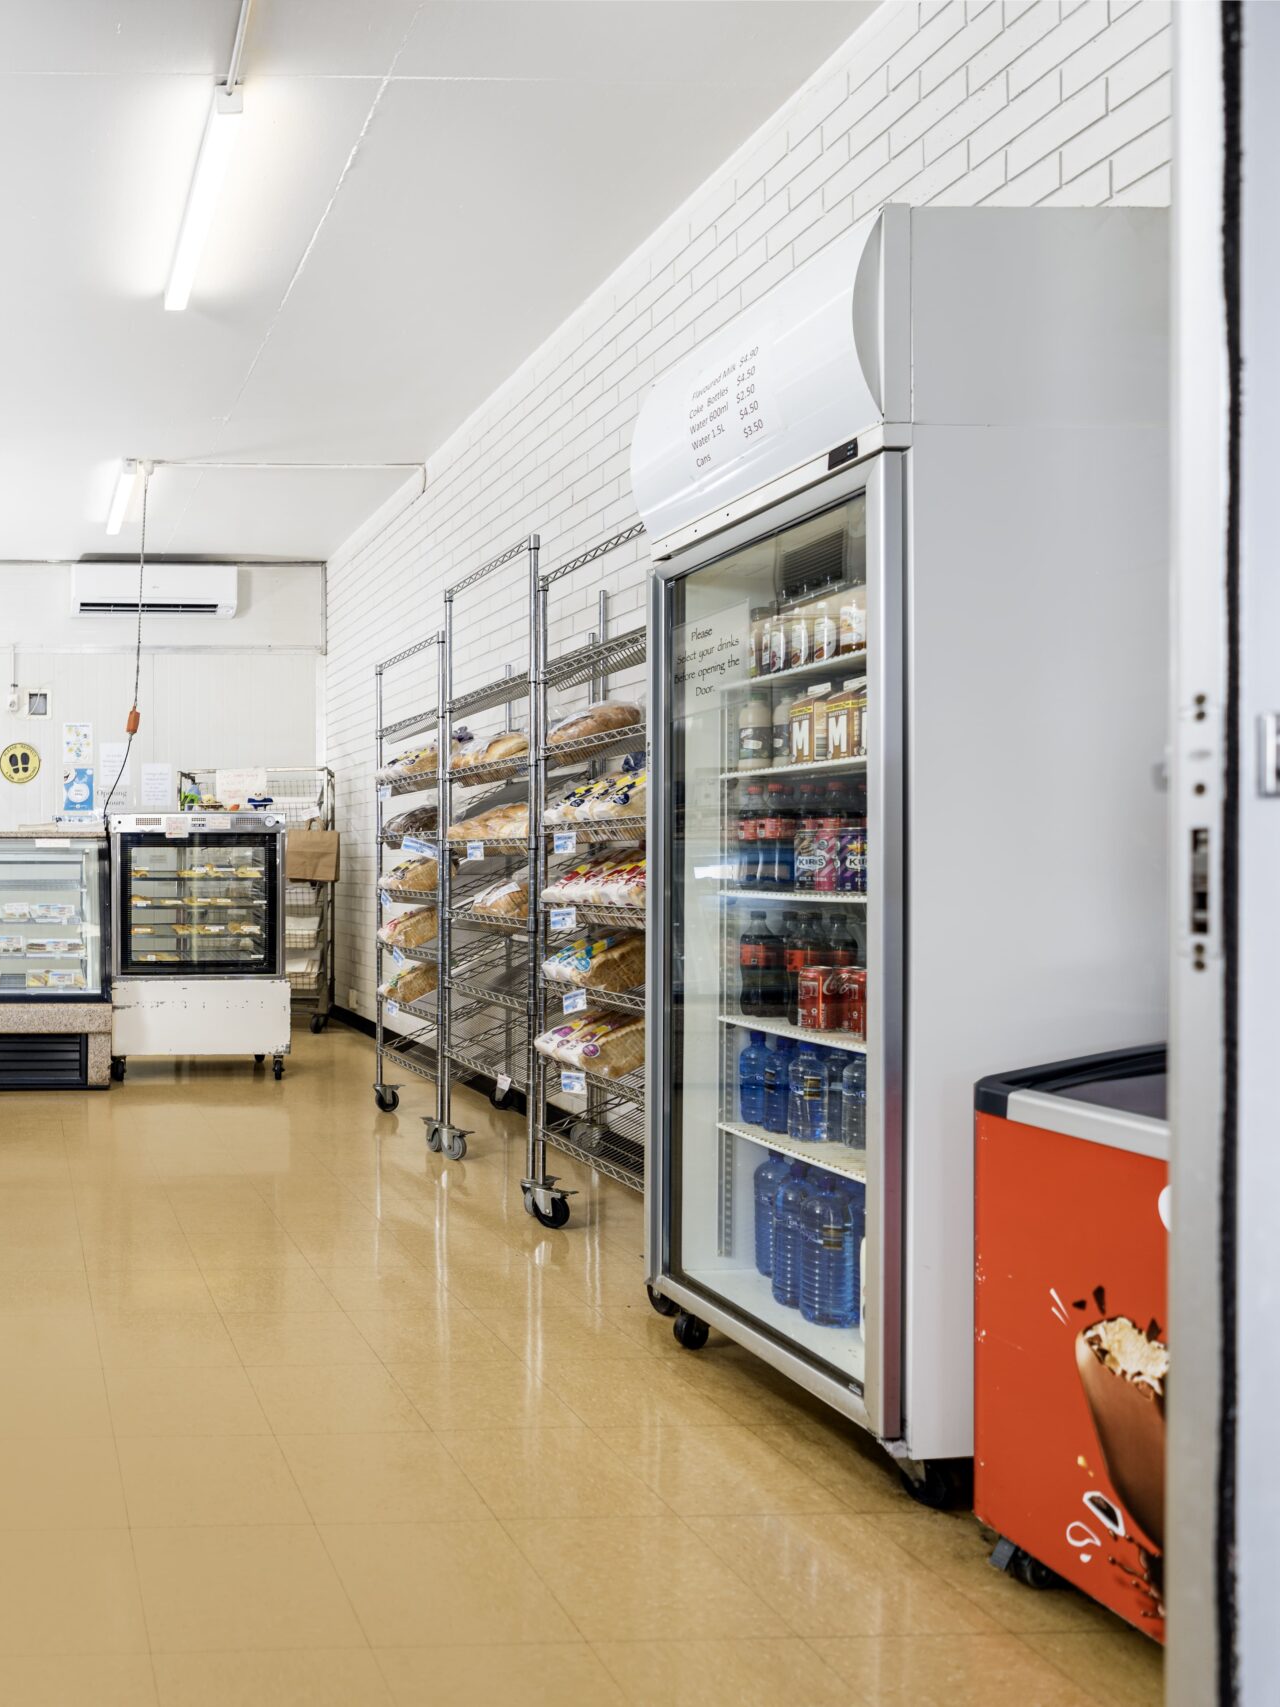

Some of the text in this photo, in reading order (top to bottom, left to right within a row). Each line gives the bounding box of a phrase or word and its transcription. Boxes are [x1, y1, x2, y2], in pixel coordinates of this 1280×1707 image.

[689, 365, 756, 419] Coke Bottles $4.50
[689, 383, 755, 435] Water 600ml $2.50
[691, 400, 759, 451] Water 1.5L $4.50
[695, 418, 764, 468] Cans $3.50
[691, 627, 713, 641] Please
[698, 646, 715, 663] your
[717, 633, 740, 651] drinks
[697, 662, 726, 681] opening
[727, 653, 740, 668] the
